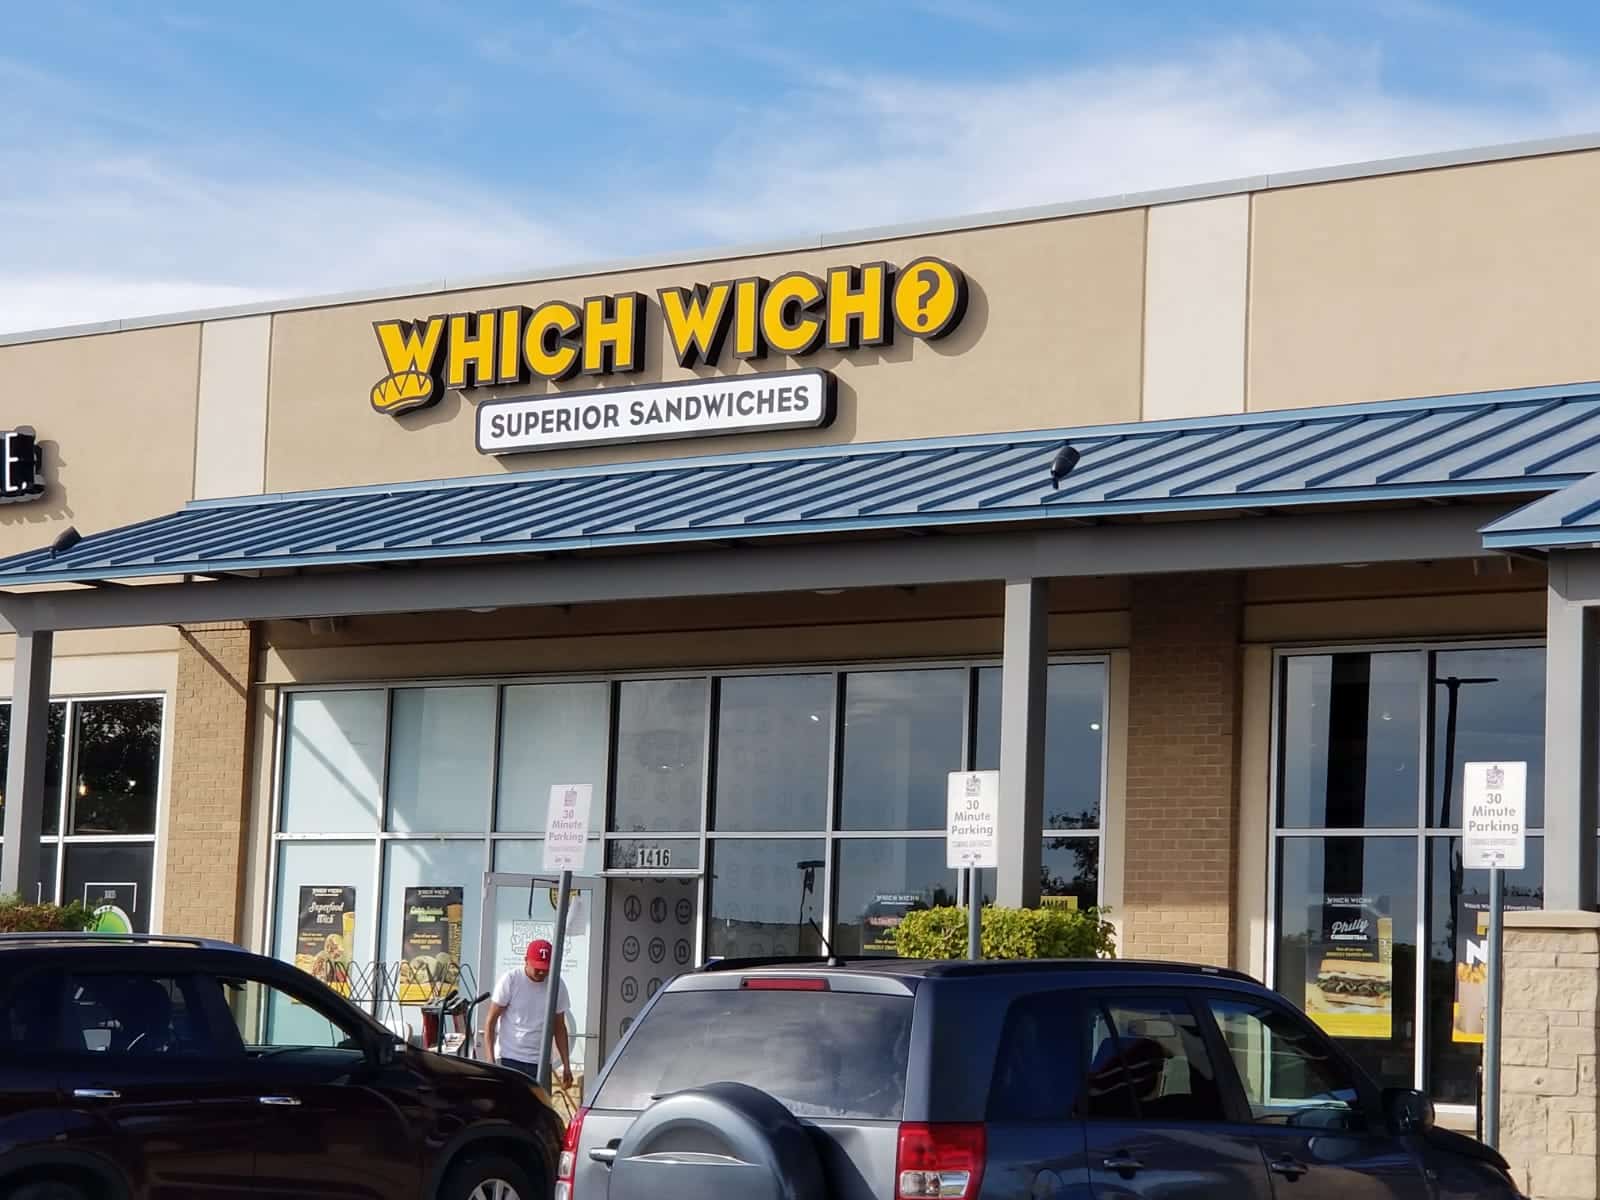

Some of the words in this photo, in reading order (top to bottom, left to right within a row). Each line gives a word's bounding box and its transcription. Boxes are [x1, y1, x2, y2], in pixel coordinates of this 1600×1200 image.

[370, 292, 640, 414] WHICH
[490, 403, 620, 438] SUPERIOR
[629, 385, 810, 426] SANDWICHES
[966, 799, 980, 810] 30
[1486, 793, 1502, 804] 30
[562, 809, 575, 819] 30
[954, 811, 991, 822] Minute
[1472, 805, 1516, 817] Minute
[552, 820, 583, 829] Minute
[951, 823, 993, 837] Parking
[1468, 819, 1519, 834] Parking
[548, 831, 584, 843] Parking
[639, 849, 670, 866] 1416
[1331, 918, 1369, 935] Philly
[539, 948, 549, 959] T
